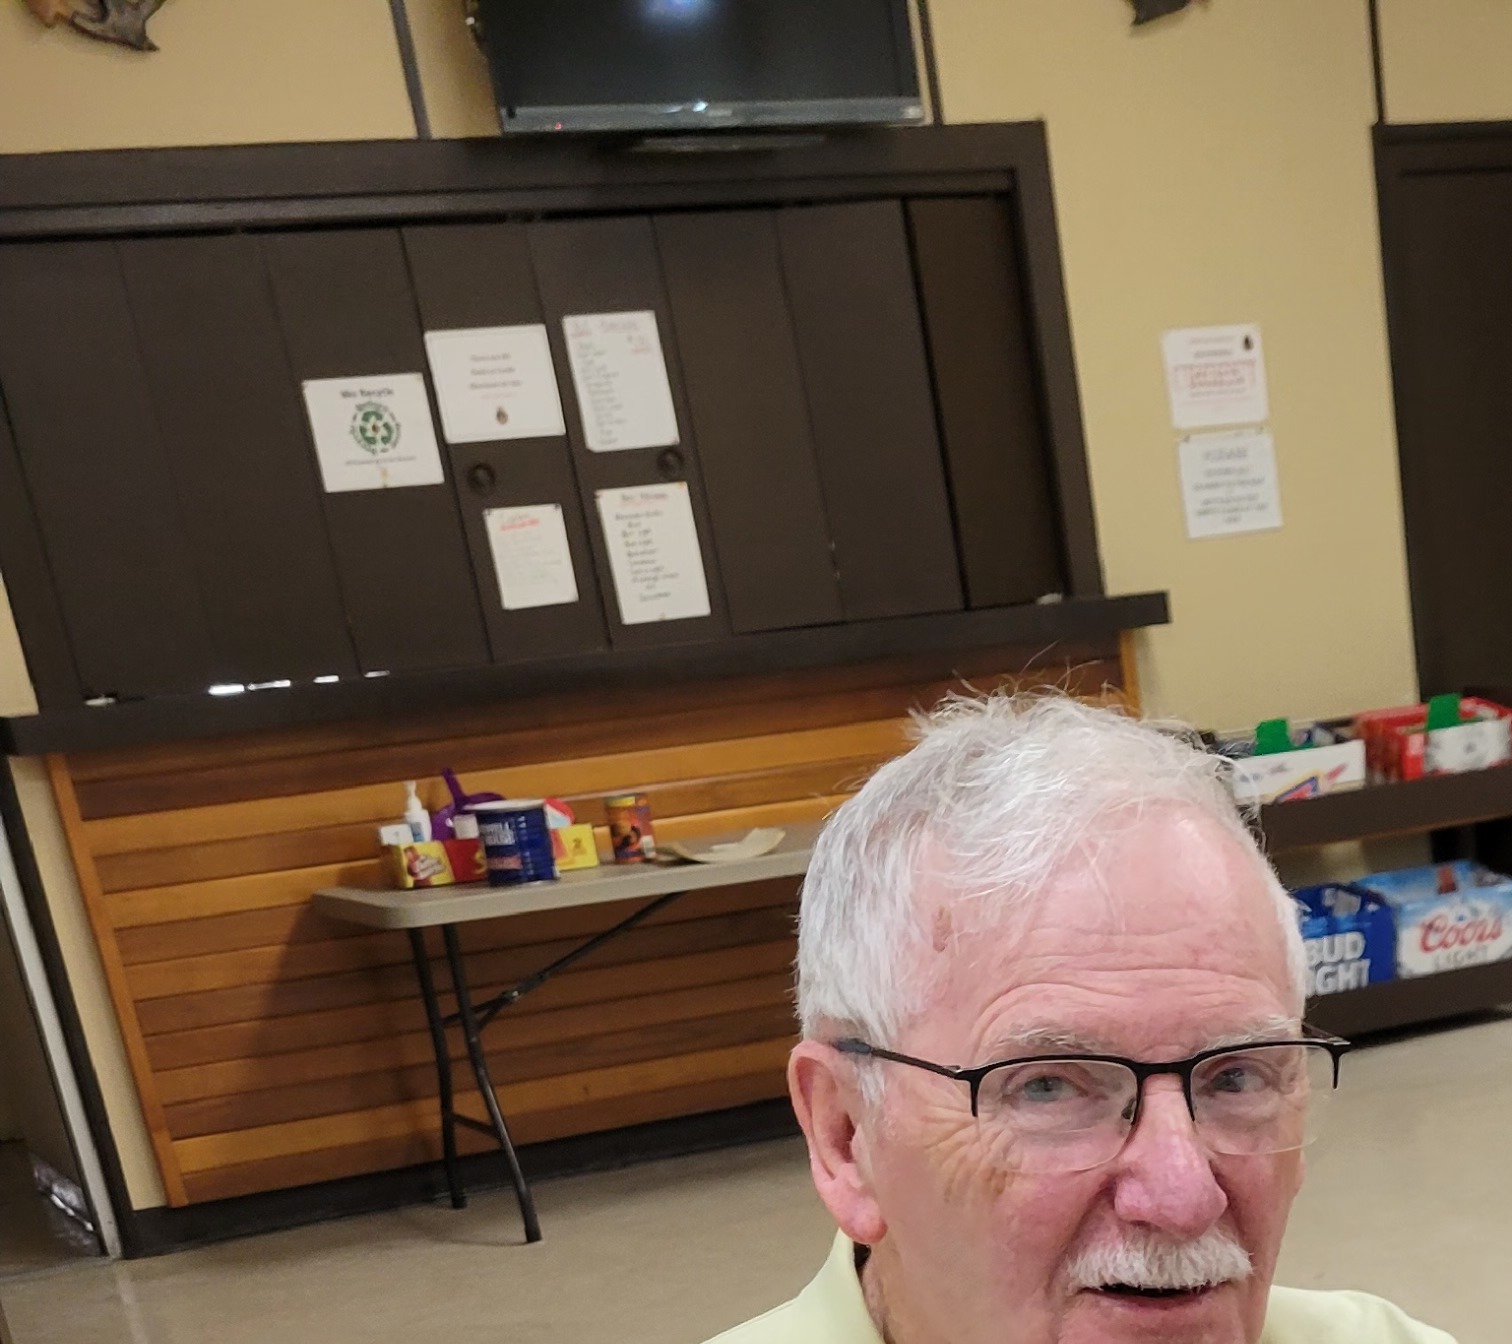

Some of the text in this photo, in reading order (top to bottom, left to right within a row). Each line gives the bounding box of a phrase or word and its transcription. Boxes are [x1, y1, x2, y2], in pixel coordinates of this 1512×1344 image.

[1303, 931, 1366, 967] BUD
[1420, 914, 1502, 953] Coors
[1305, 959, 1371, 998] IGHT
